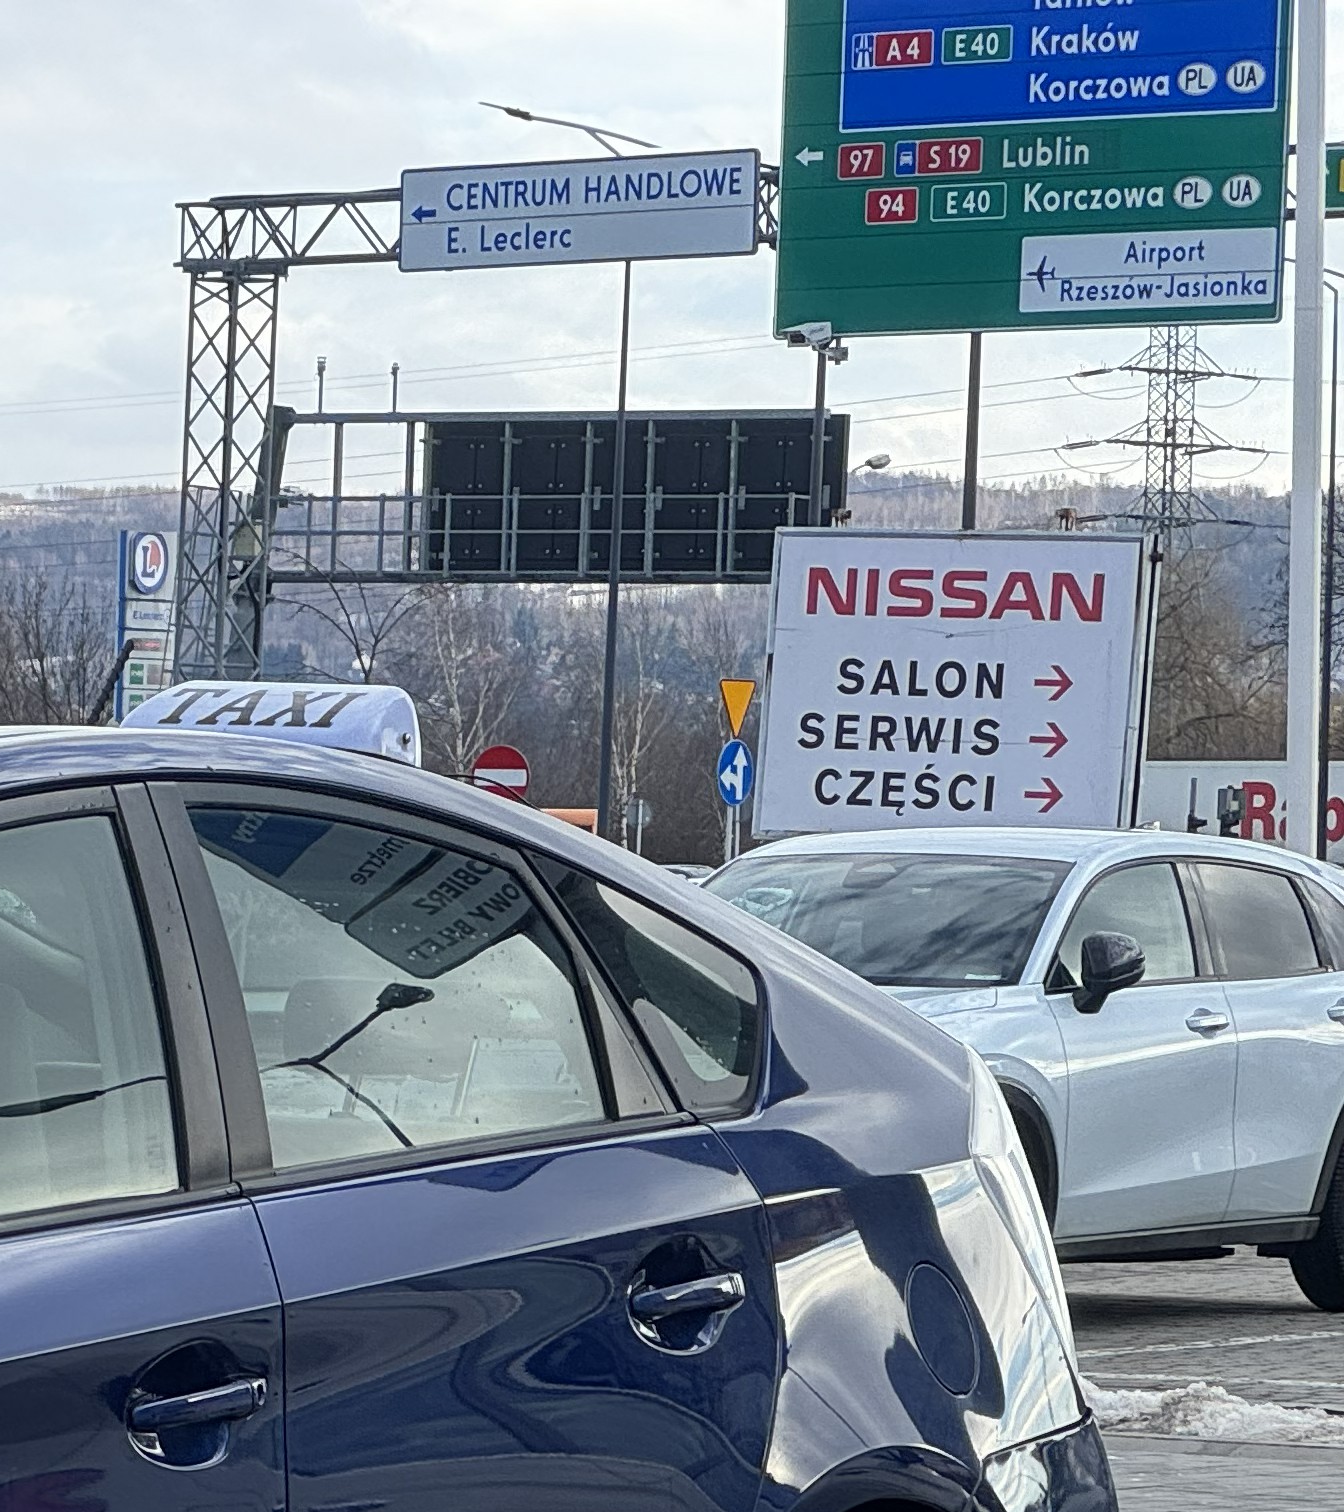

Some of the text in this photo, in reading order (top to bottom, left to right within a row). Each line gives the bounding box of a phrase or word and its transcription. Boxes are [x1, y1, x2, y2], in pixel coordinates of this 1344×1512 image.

[1030, 22, 1140, 56] Kraków
[1028, 66, 1258, 103] Korczowa PL UA
[849, 149, 874, 174] 97
[1002, 136, 1090, 168] Lublin
[446, 167, 742, 212] CENTRUM HANDLOWE
[878, 193, 905, 218] 94
[1023, 182, 1164, 213] Korczowa
[1180, 182, 1205, 204] PL
[1229, 180, 1253, 201] UA
[447, 222, 572, 254] E. Leclerc
[1124, 240, 1205, 270] Airport
[1060, 271, 1268, 303] Rzeszów-Jasionka
[805, 566, 1106, 622] NISSAN
[836, 657, 1006, 700] SALON
[157, 687, 369, 729] TAXI
[797, 713, 1002, 756] SERWIS
[814, 763, 996, 817] CZĘŚCI
